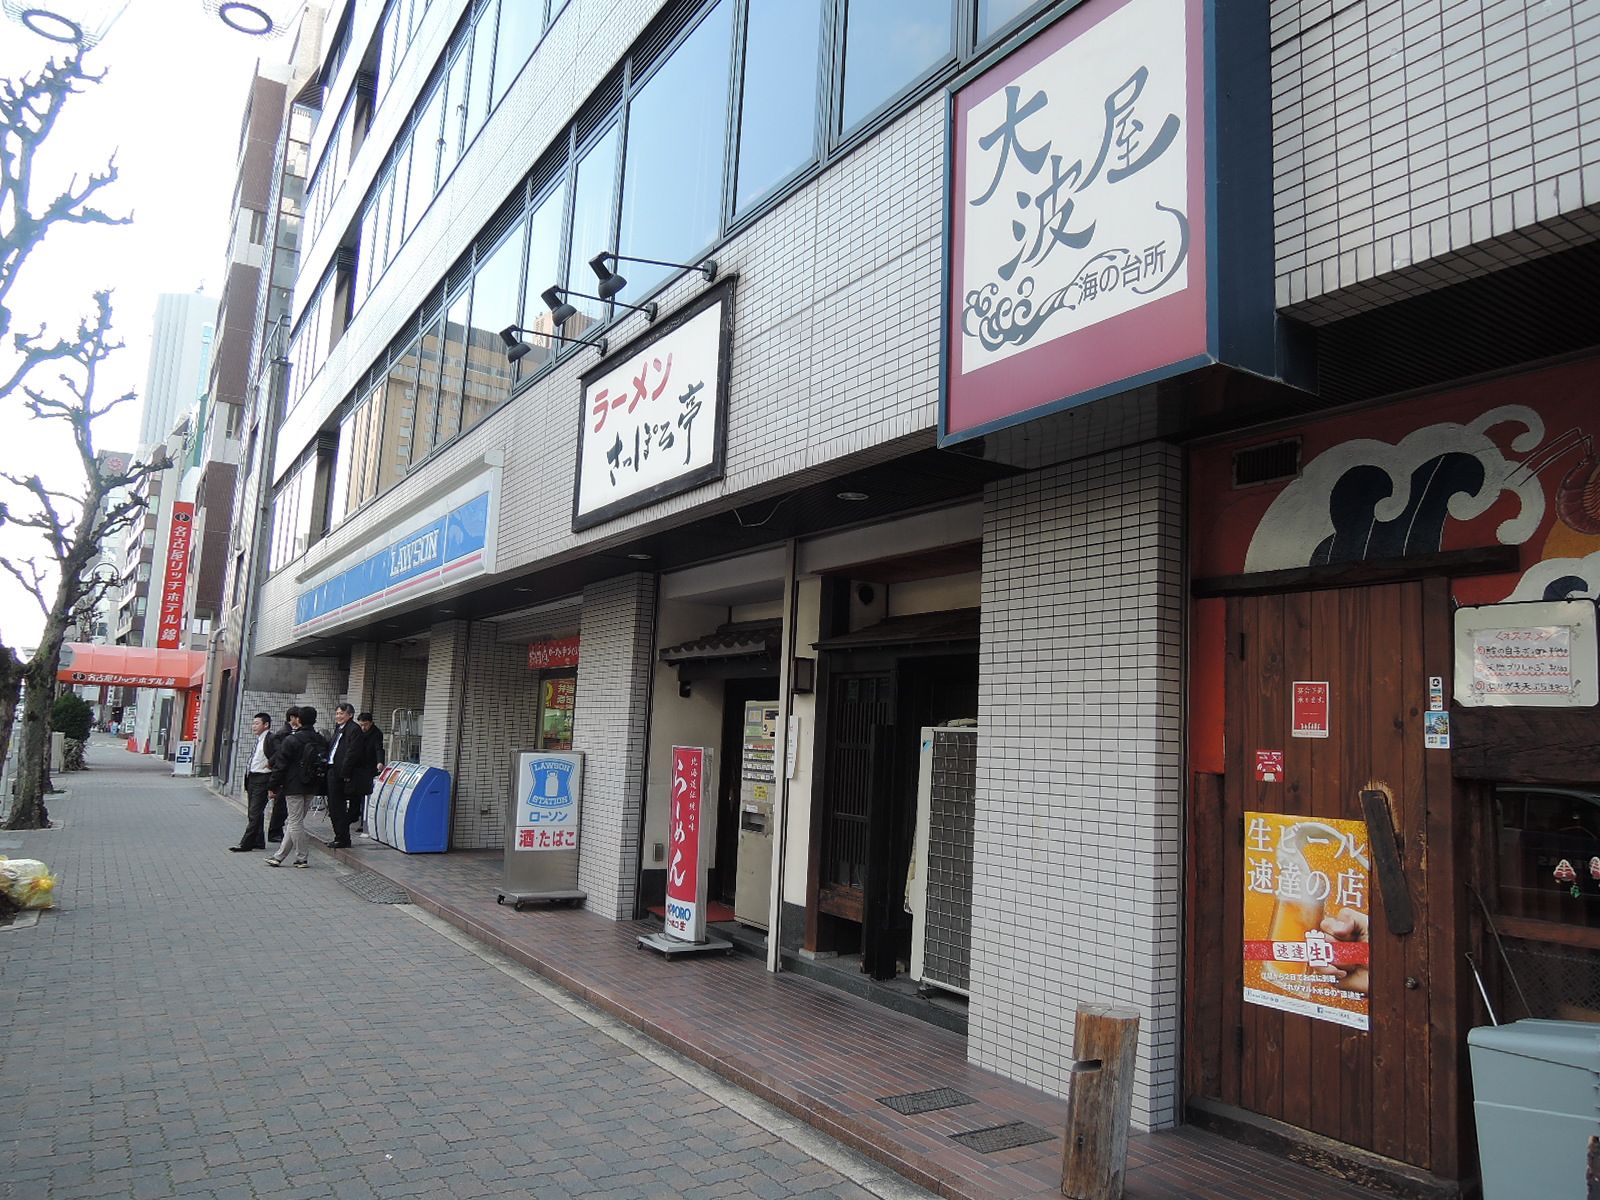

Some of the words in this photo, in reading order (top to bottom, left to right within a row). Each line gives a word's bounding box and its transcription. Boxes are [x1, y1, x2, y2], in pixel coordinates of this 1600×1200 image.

[1077, 240, 1166, 304] 海の台所
[593, 353, 673, 433] ラーメン
[164, 526, 188, 625] 名古屋リッチホテル
[390, 528, 440, 577] LAWSON
[534, 761, 571, 773] LAWSON
[529, 811, 568, 822] ローソン
[532, 795, 568, 806] STATION
[669, 759, 688, 887] らーめん
[1248, 818, 1366, 858] 生ビール
[1247, 857, 1365, 908] 速達の店
